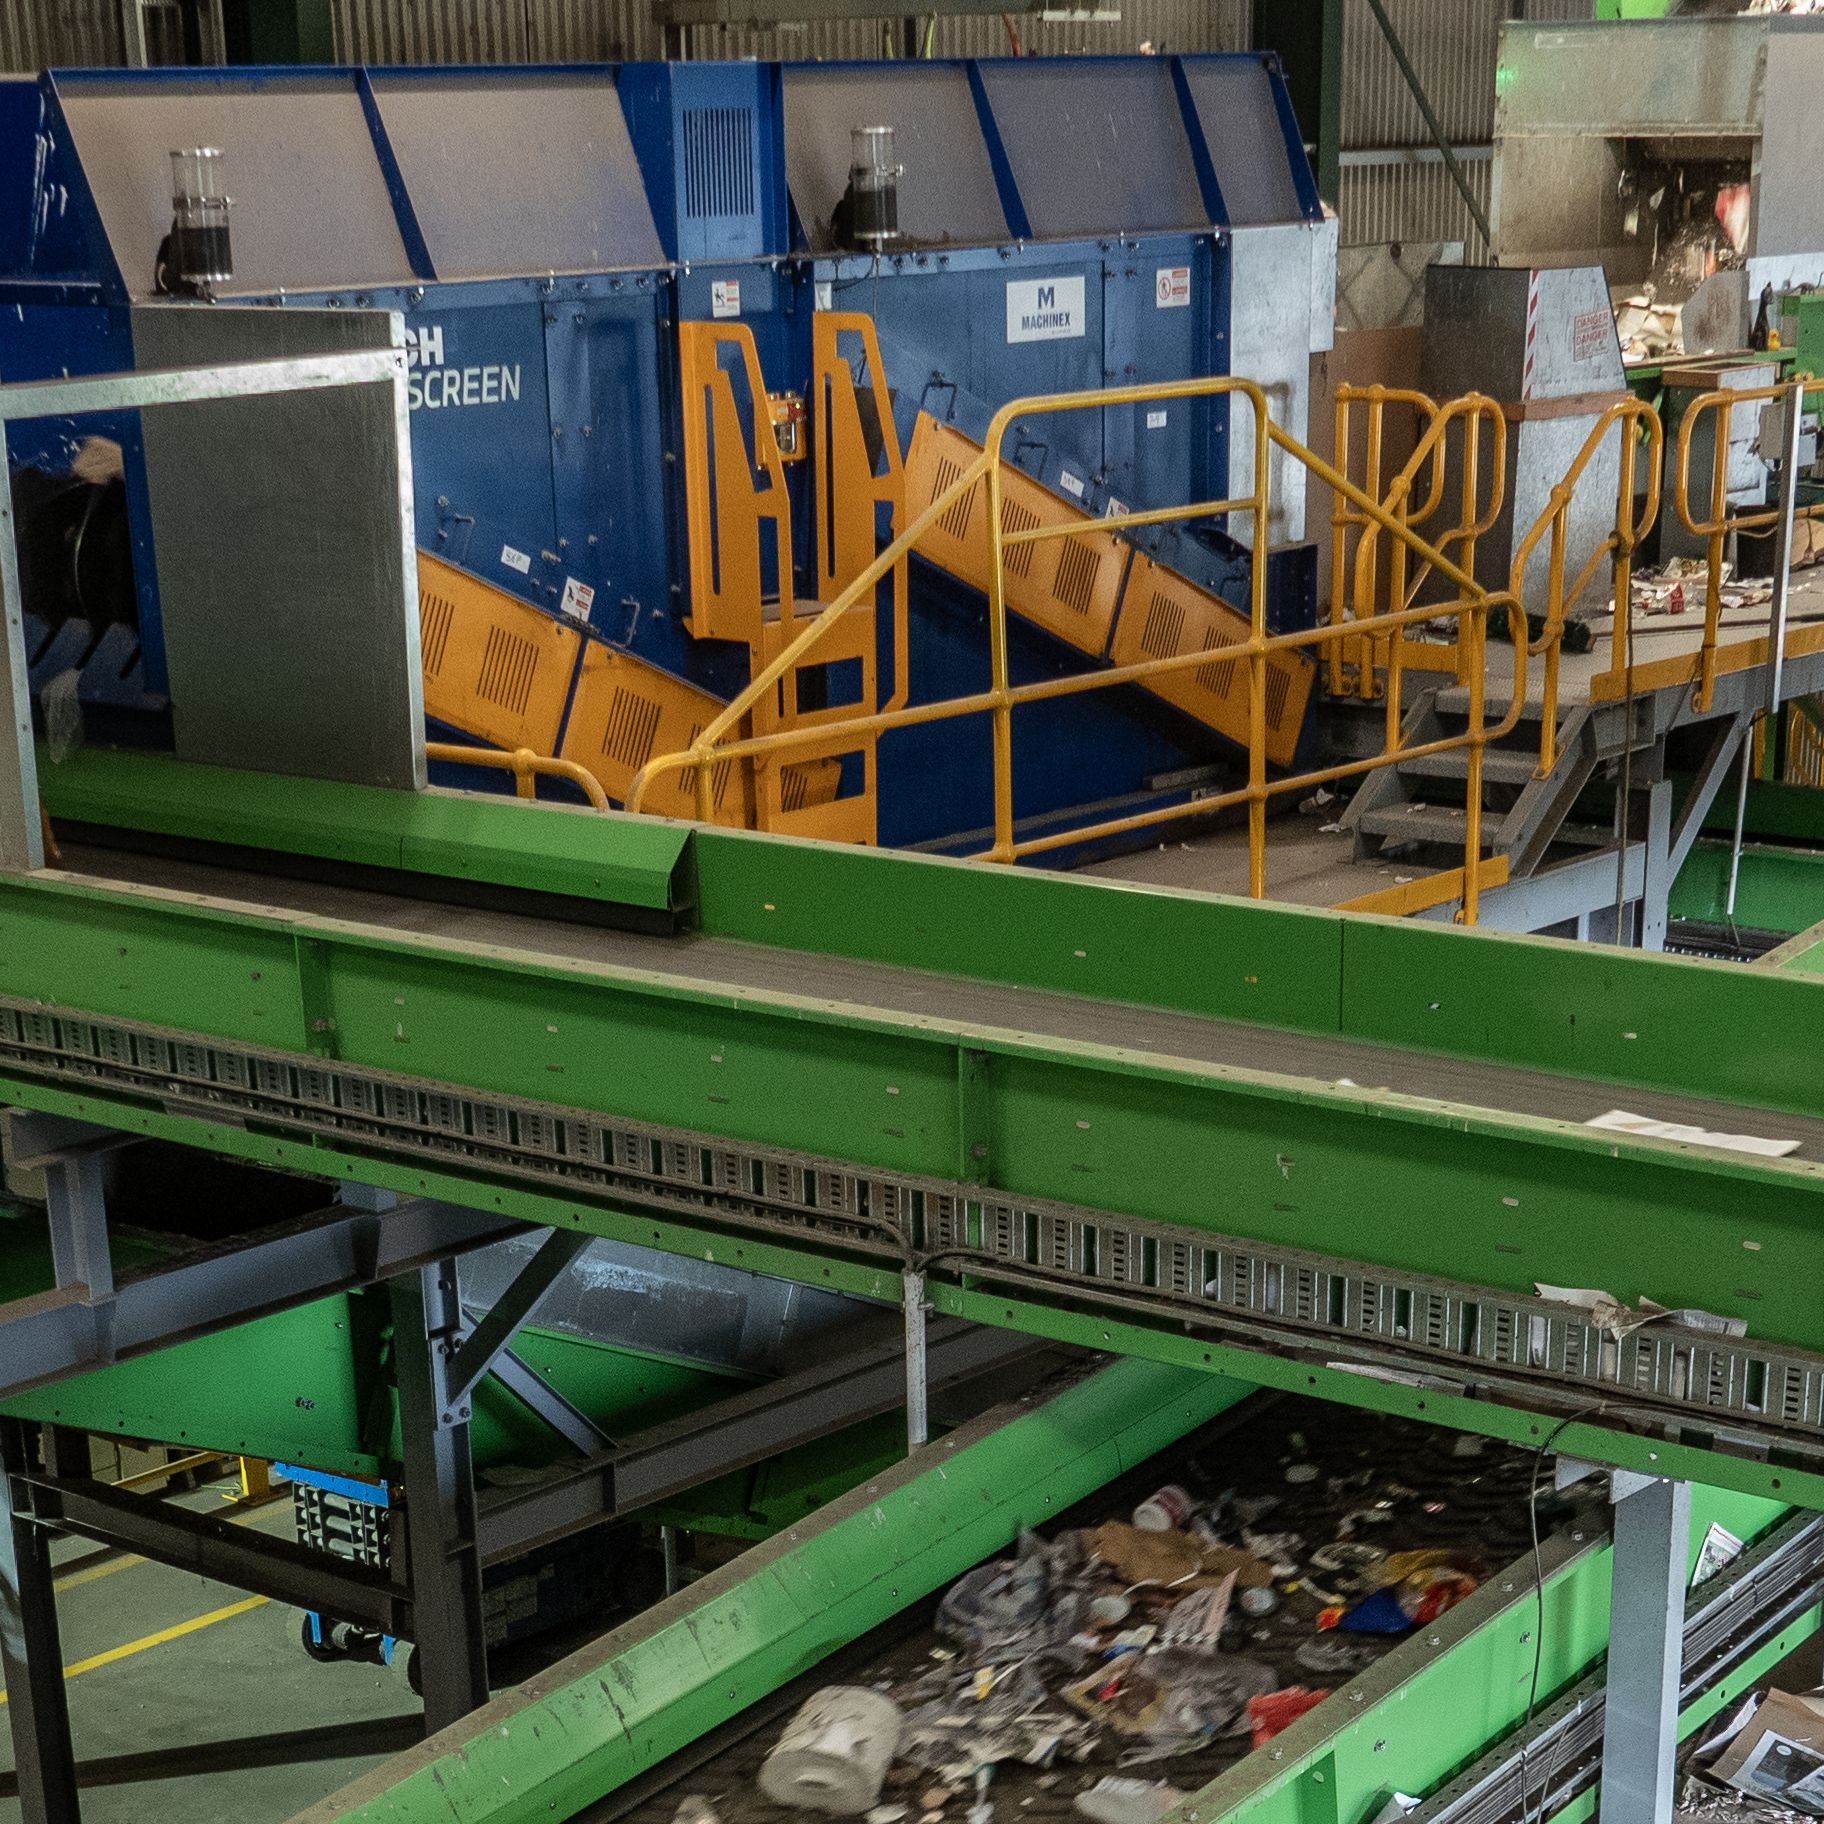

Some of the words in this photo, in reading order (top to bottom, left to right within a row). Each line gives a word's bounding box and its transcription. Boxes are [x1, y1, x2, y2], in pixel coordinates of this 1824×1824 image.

[1037, 286, 1055, 309] M
[1021, 311, 1071, 331] MACHINEX
[407, 364, 521, 411] SCREEN
